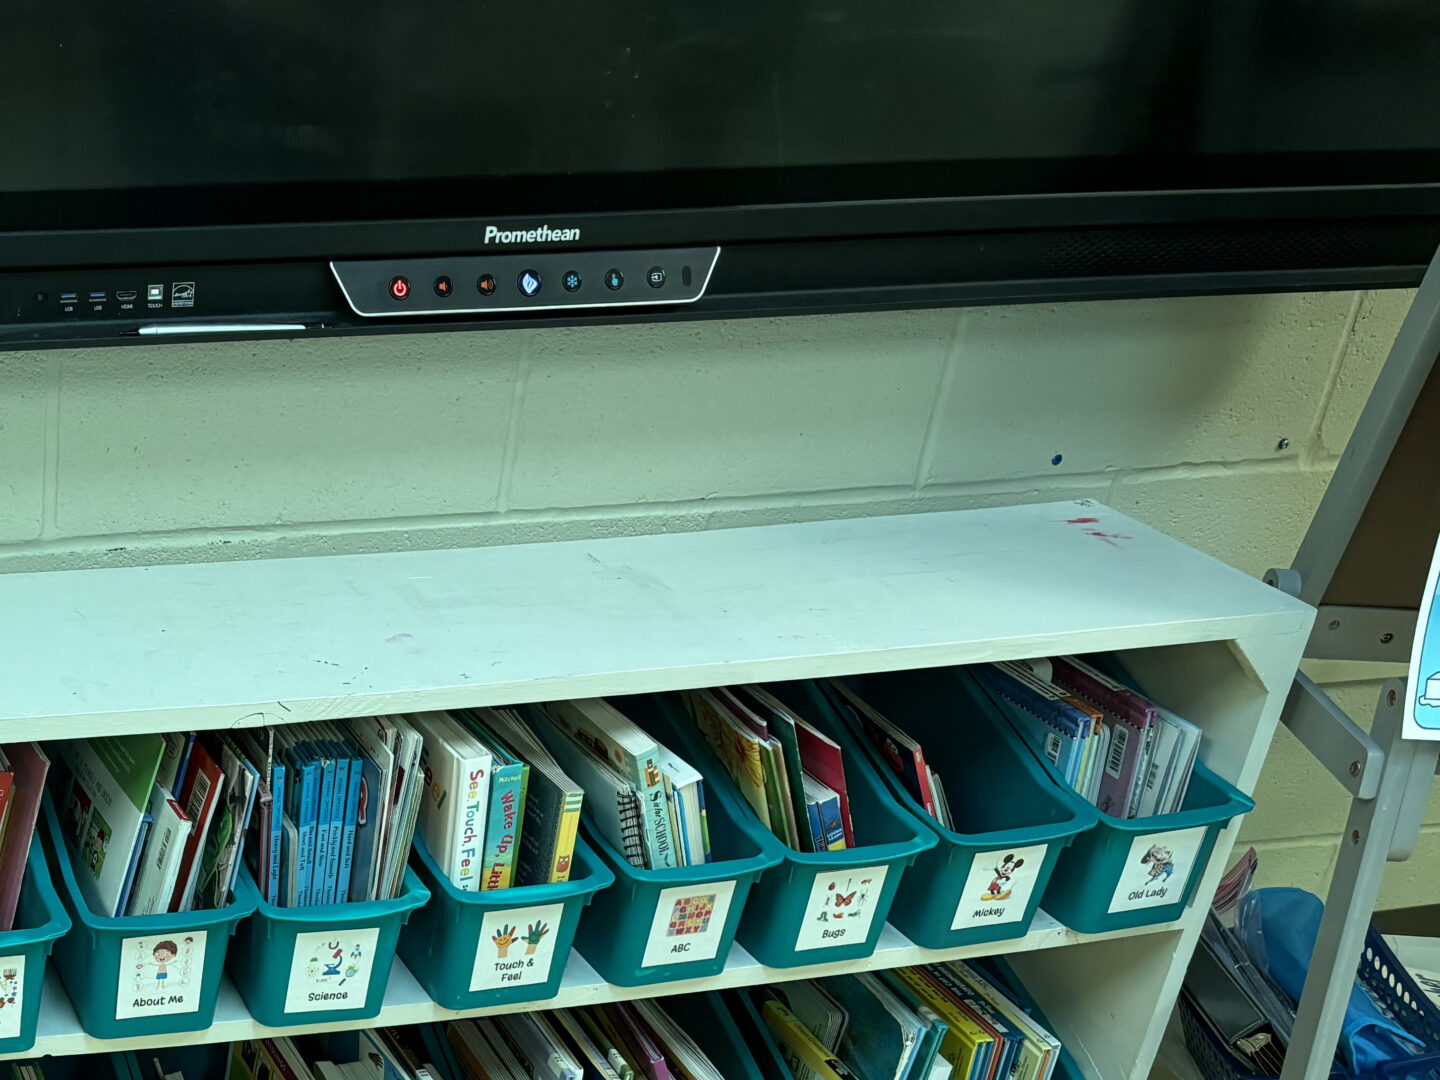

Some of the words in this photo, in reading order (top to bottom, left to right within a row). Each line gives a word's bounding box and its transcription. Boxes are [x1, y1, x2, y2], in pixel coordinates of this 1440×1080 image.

[484, 224, 580, 245] Promethean
[501, 789, 517, 831] Wake
[654, 816, 670, 855] SCHOOL
[459, 848, 476, 882] Feel
[487, 862, 505, 891] Littl
[1127, 889, 1145, 901] Old
[1146, 886, 1168, 900] Lady
[972, 906, 1005, 919] Mickey
[821, 927, 847, 940] Bugs
[670, 942, 691, 954] ABC
[493, 959, 524, 972] Touch
[526, 959, 534, 967] &
[501, 970, 523, 982] Feel
[132, 996, 166, 1008] About
[167, 995, 184, 1004] Me
[308, 991, 349, 1002] Science
